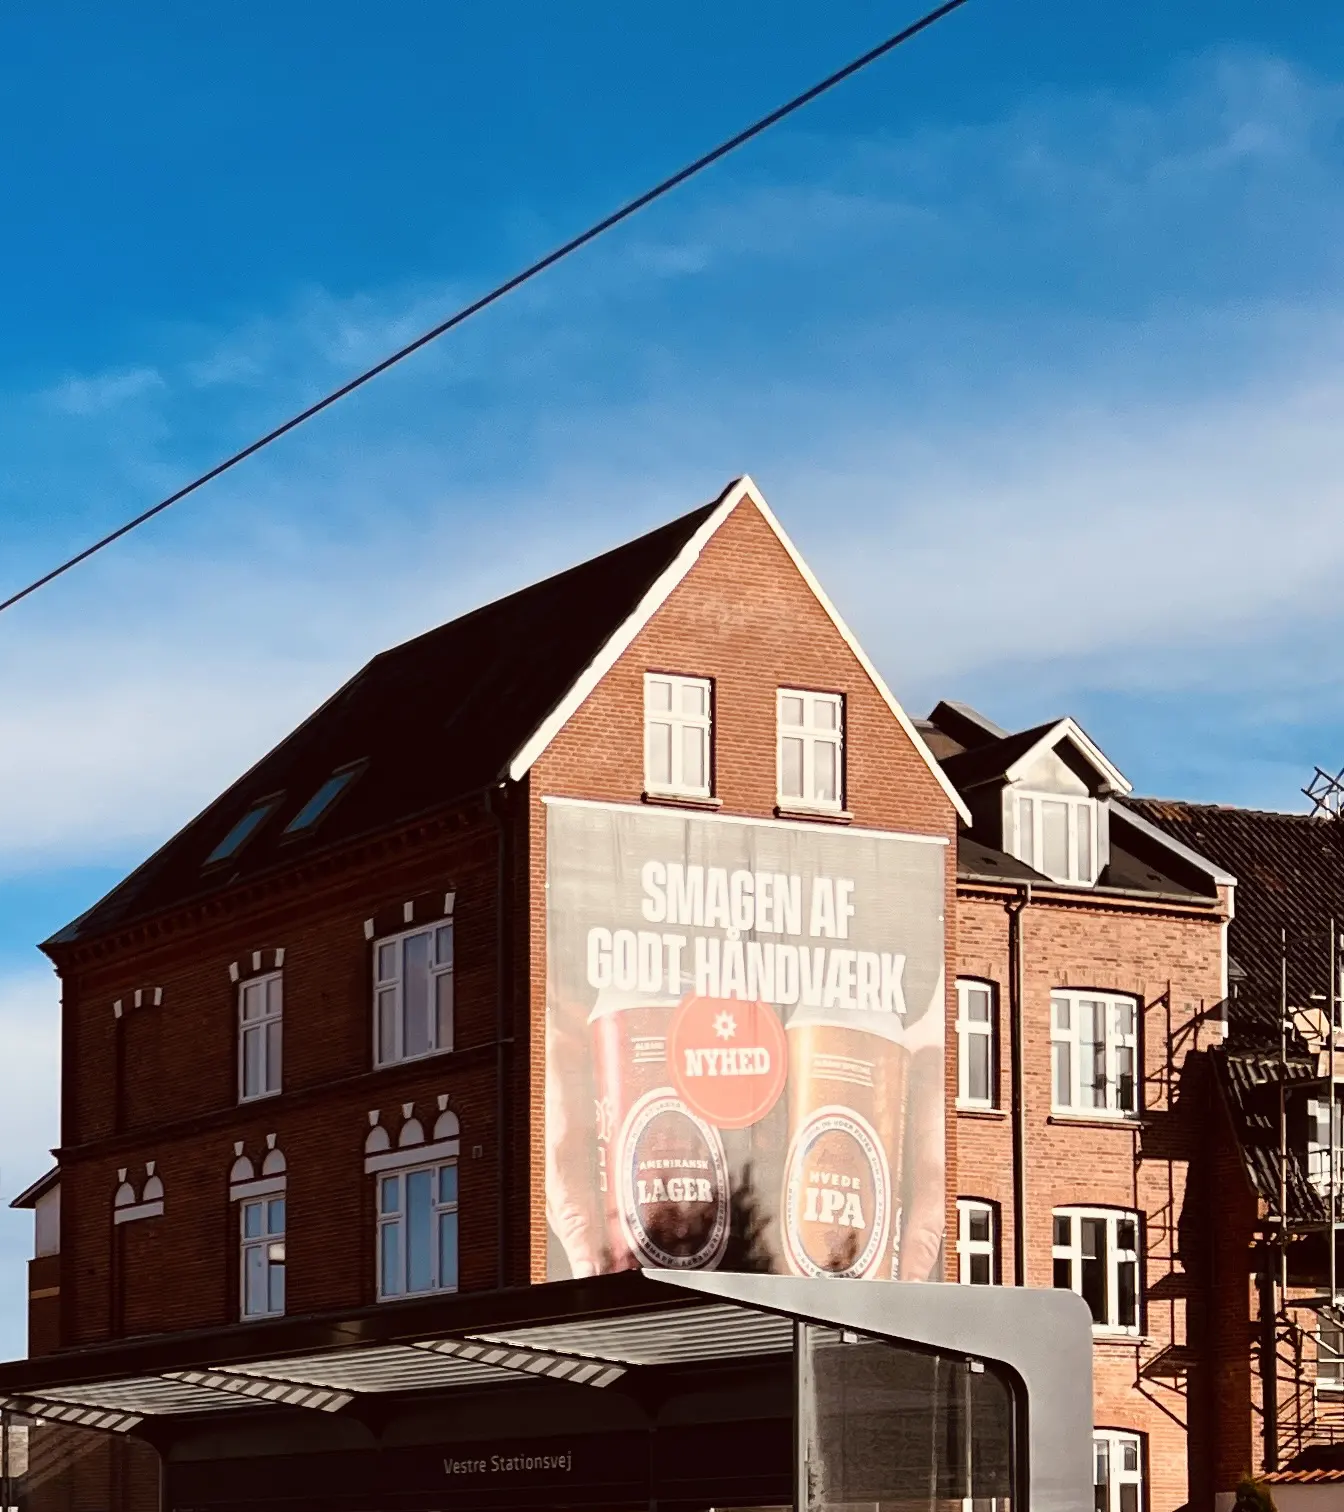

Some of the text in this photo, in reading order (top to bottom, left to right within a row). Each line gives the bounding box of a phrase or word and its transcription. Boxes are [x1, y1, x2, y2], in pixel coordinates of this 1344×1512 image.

[641, 861, 855, 939] SMAGEN AF
[587, 926, 907, 1013] GODT HÅNDVÆRK
[683, 1047, 770, 1077] NYHED
[637, 1177, 713, 1204] LAGER
[809, 1170, 861, 1190] HVEDE
[803, 1187, 866, 1230] IPA
[443, 1451, 572, 1474] Vestre Stationsvej
